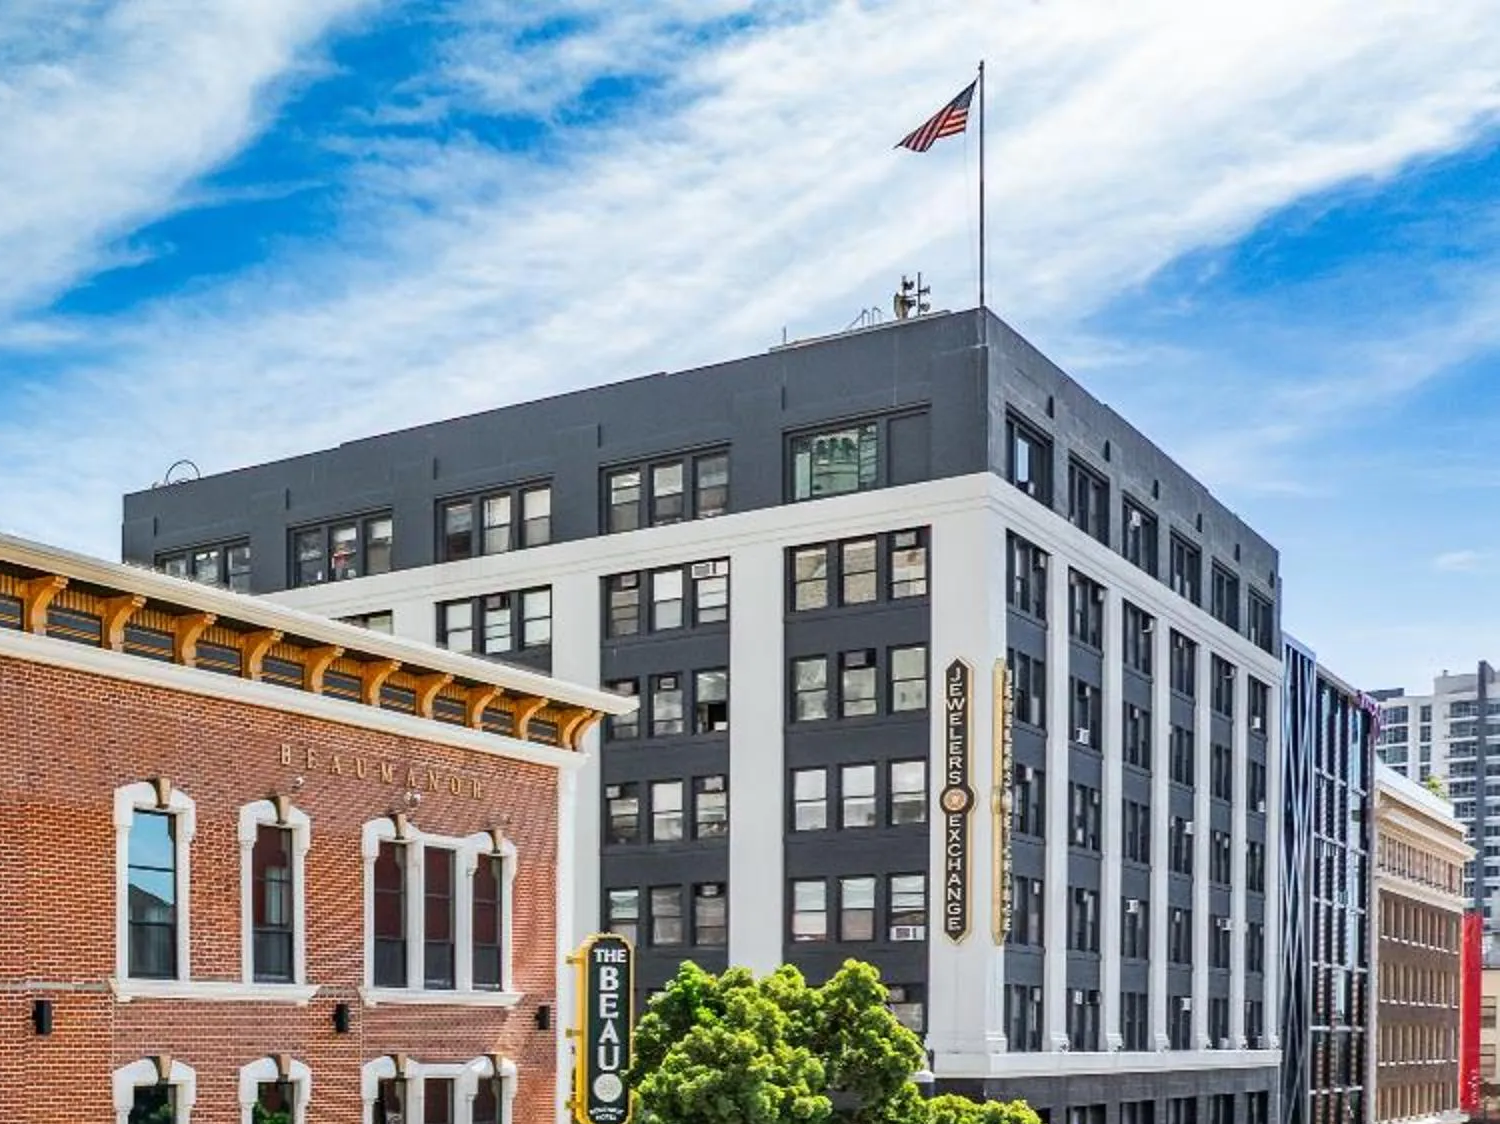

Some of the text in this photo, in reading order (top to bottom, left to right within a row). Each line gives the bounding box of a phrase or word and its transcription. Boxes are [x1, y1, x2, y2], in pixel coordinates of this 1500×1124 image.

[280, 744, 482, 799] BEAUMANOR
[946, 667, 965, 932] JEWELERS EXCHANGE
[594, 948, 627, 963] THE
[598, 965, 620, 1071] BEAU
